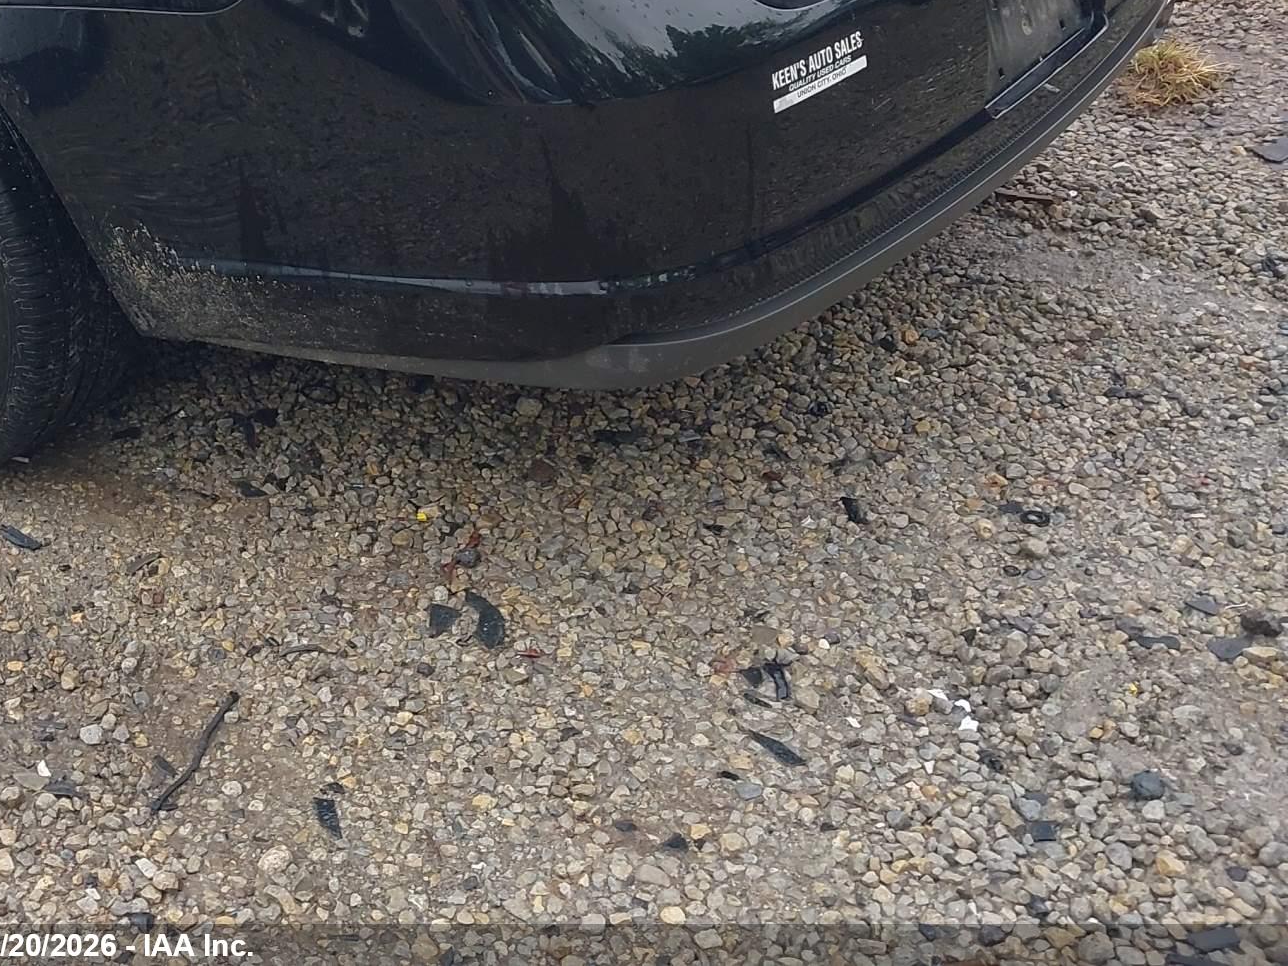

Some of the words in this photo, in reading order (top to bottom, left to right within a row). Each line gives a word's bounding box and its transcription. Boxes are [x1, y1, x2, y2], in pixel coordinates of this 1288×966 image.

[771, 59, 807, 91] KEEN'S
[808, 46, 833, 76] AUTO
[834, 30, 863, 59] SALES
[788, 73, 816, 92] QUALITY
[817, 64, 834, 78] USED
[834, 54, 852, 69] CARS
[797, 83, 817, 98] UNION
[832, 68, 847, 81] OHIO
